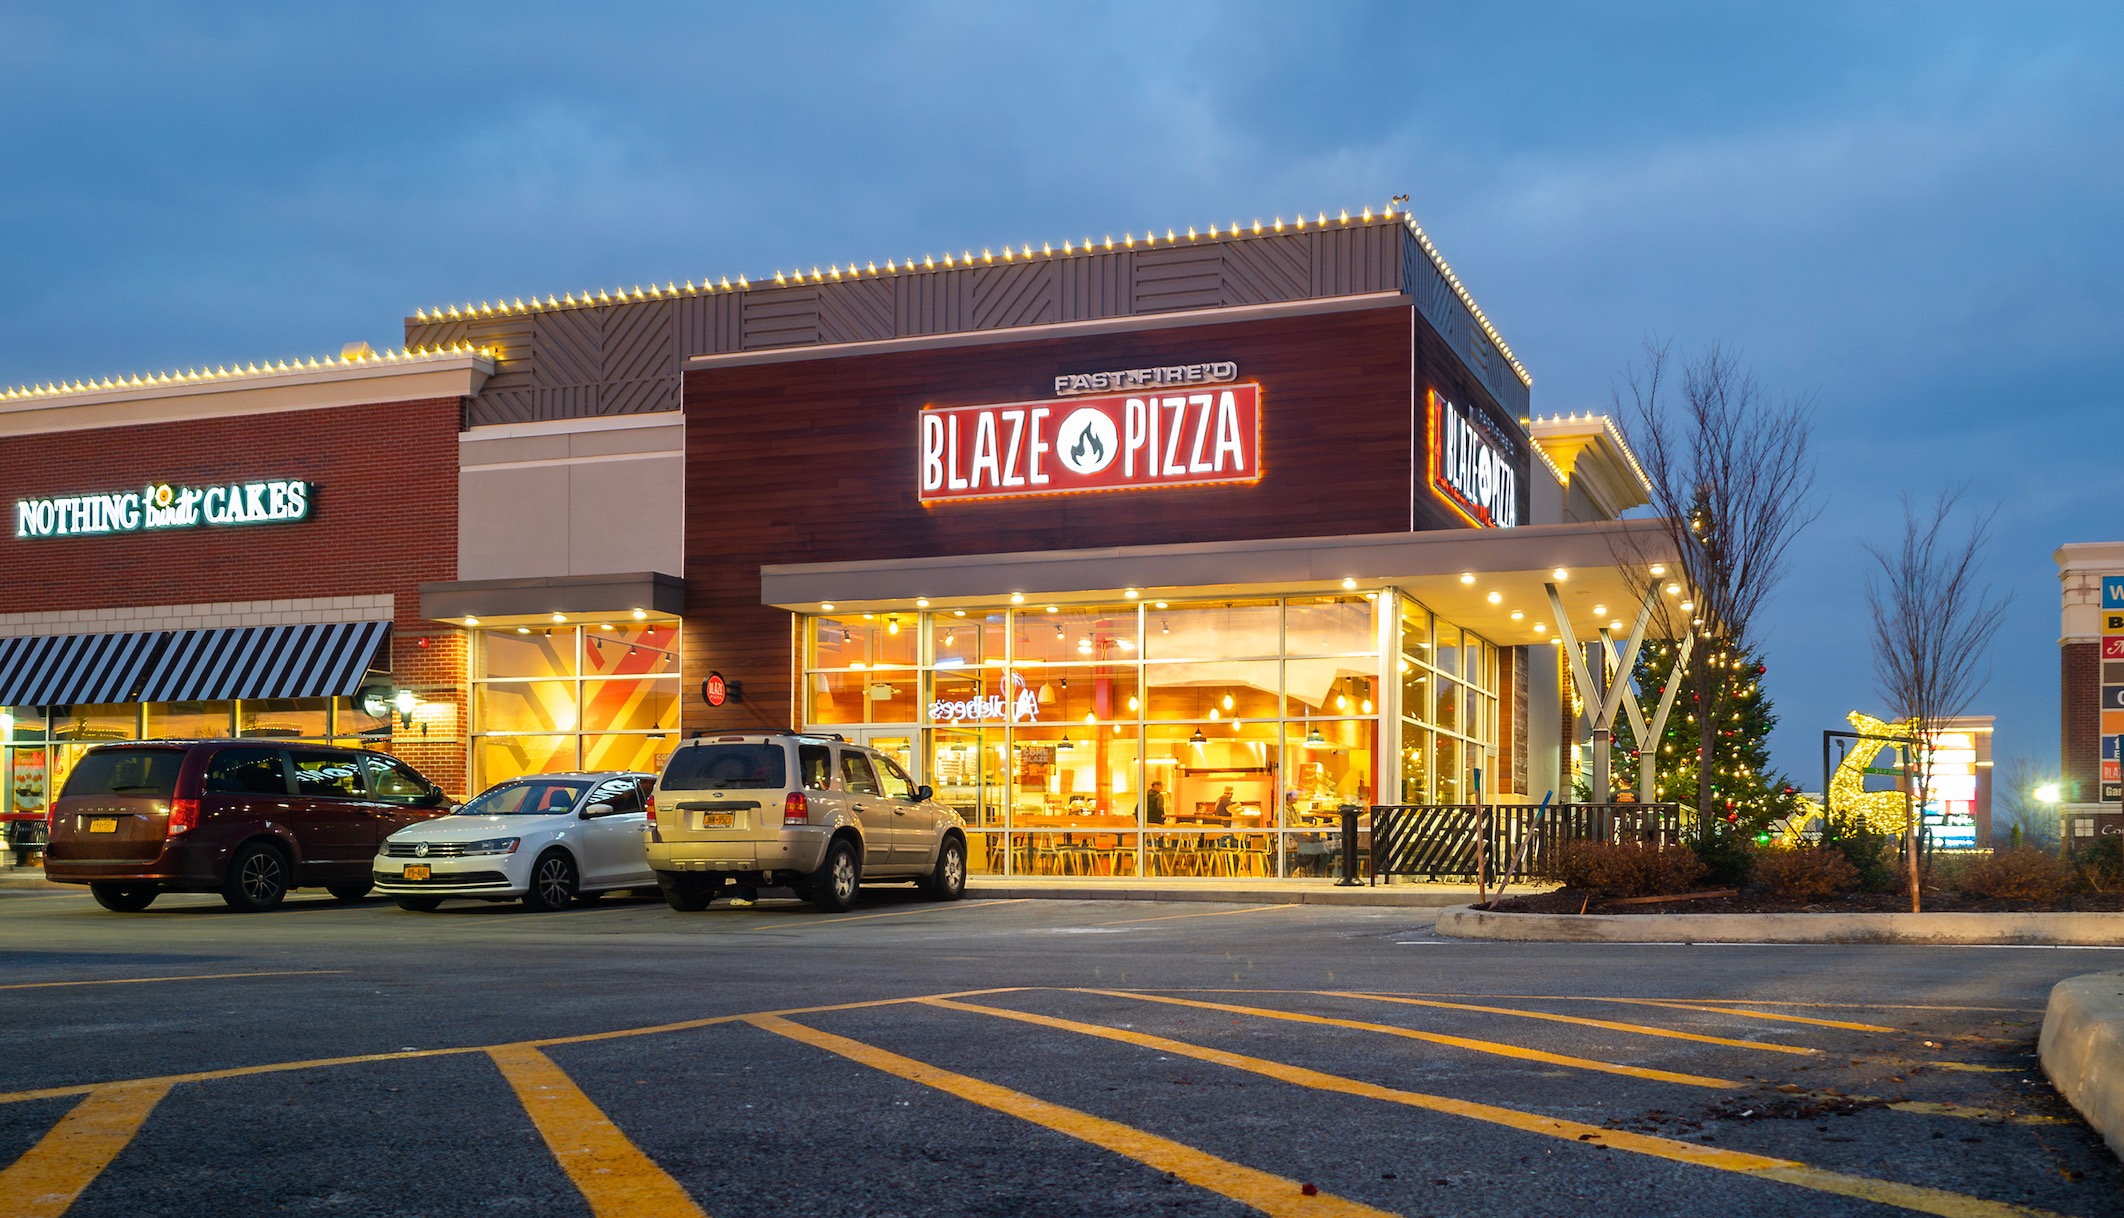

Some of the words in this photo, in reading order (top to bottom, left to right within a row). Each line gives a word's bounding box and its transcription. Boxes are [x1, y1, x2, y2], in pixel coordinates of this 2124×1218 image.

[923, 407, 1050, 491] BLAZE
[1125, 390, 1245, 478] PIZZA
[1446, 401, 1479, 504] BLAZE
[1491, 449, 1516, 528] PIZZA
[18, 494, 141, 537] NOTHING
[203, 480, 307, 524] CAKES
